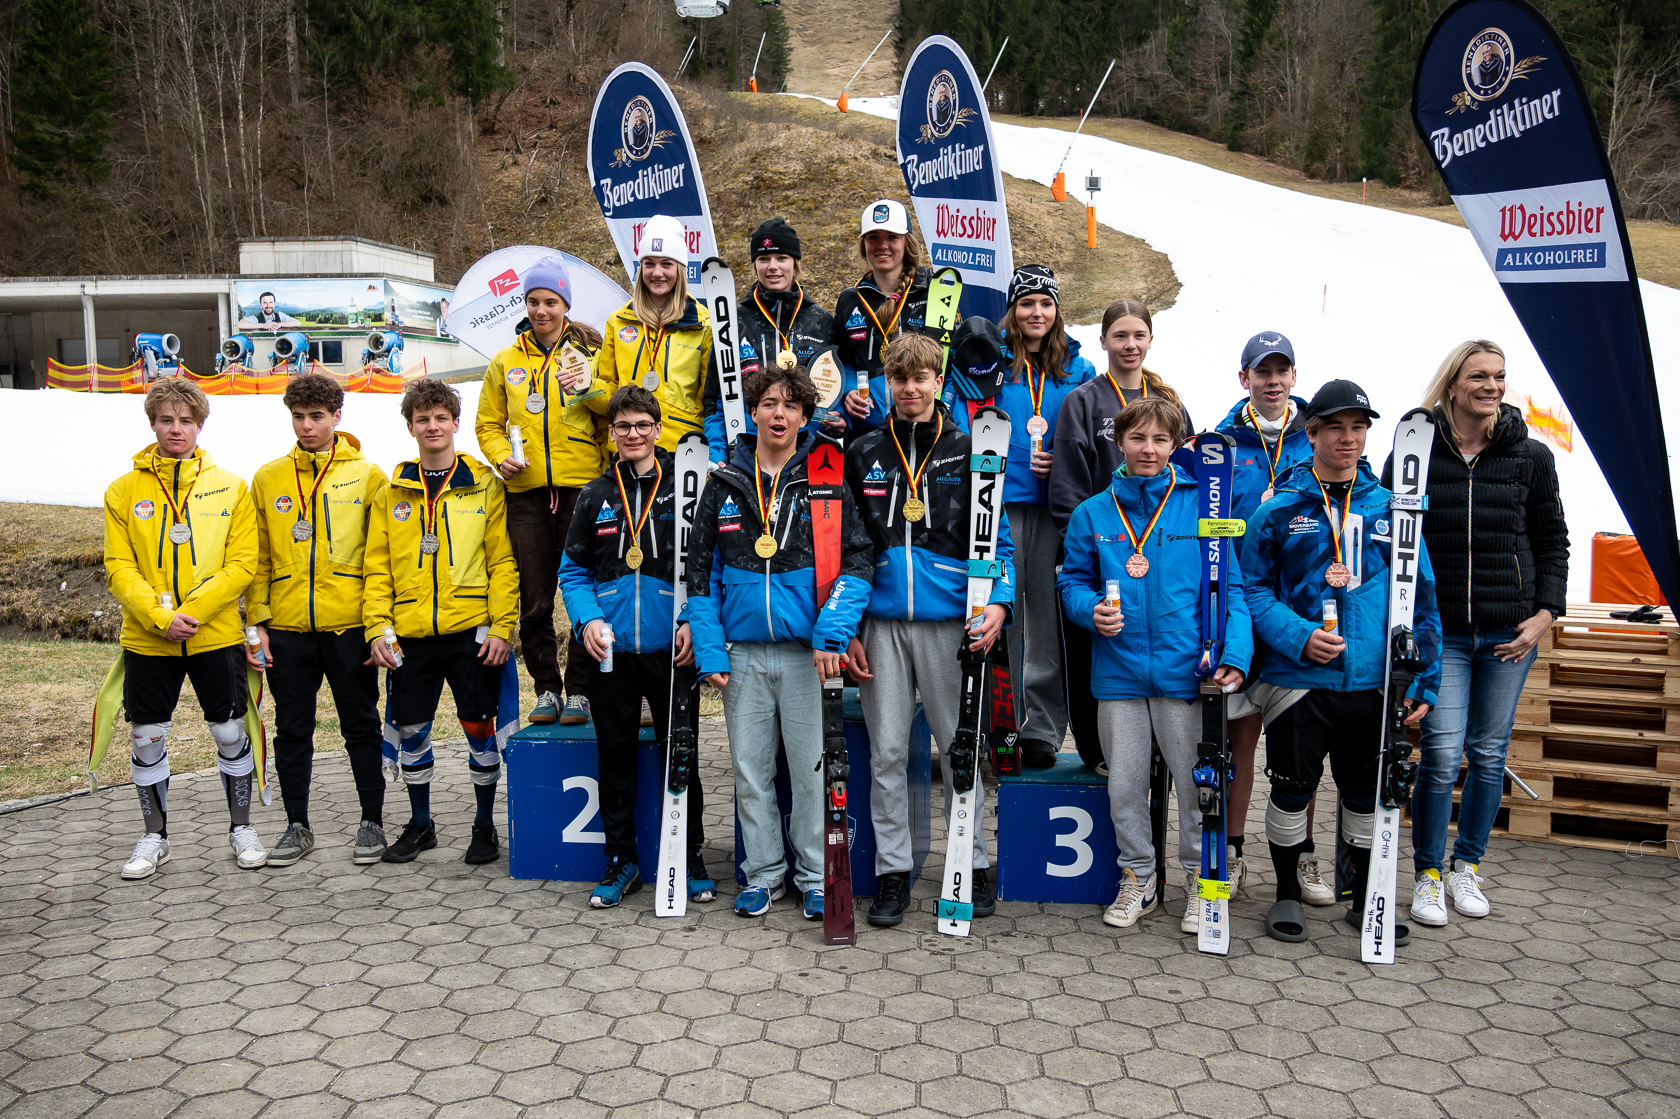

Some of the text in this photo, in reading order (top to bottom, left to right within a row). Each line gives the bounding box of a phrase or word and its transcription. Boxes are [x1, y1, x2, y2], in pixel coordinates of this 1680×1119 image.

[1466, 33, 1510, 74] BENEDIKTINER
[929, 74, 956, 108] BENEDIKTINER
[624, 100, 653, 133] BENEDIKTINER
[1430, 88, 1562, 169] Benediktiner
[905, 143, 985, 195] Benediktiner
[600, 162, 685, 216] Benediktiner
[935, 203, 997, 242] Weissbier
[1499, 200, 1605, 242] Weissbier
[934, 248, 993, 268] ALKOHOLFREI
[1503, 249, 1598, 266] ALKOHOLFREI
[845, 316, 866, 328] ASV
[714, 295, 739, 401] HEAD
[865, 471, 887, 481] ASV
[941, 454, 965, 465] ziener
[596, 509, 616, 521] ASV
[719, 504, 739, 516] ASV
[1208, 476, 1221, 563] SAMON
[1108, 533, 1126, 541] SVM
[1399, 588, 1407, 601] R
[137, 788, 152, 816] SOCKS
[236, 778, 249, 807] SOCKS
[562, 775, 606, 844] 2
[1046, 806, 1094, 878] 3
[667, 866, 676, 909] HEAD
[1373, 896, 1385, 956] HEAD
